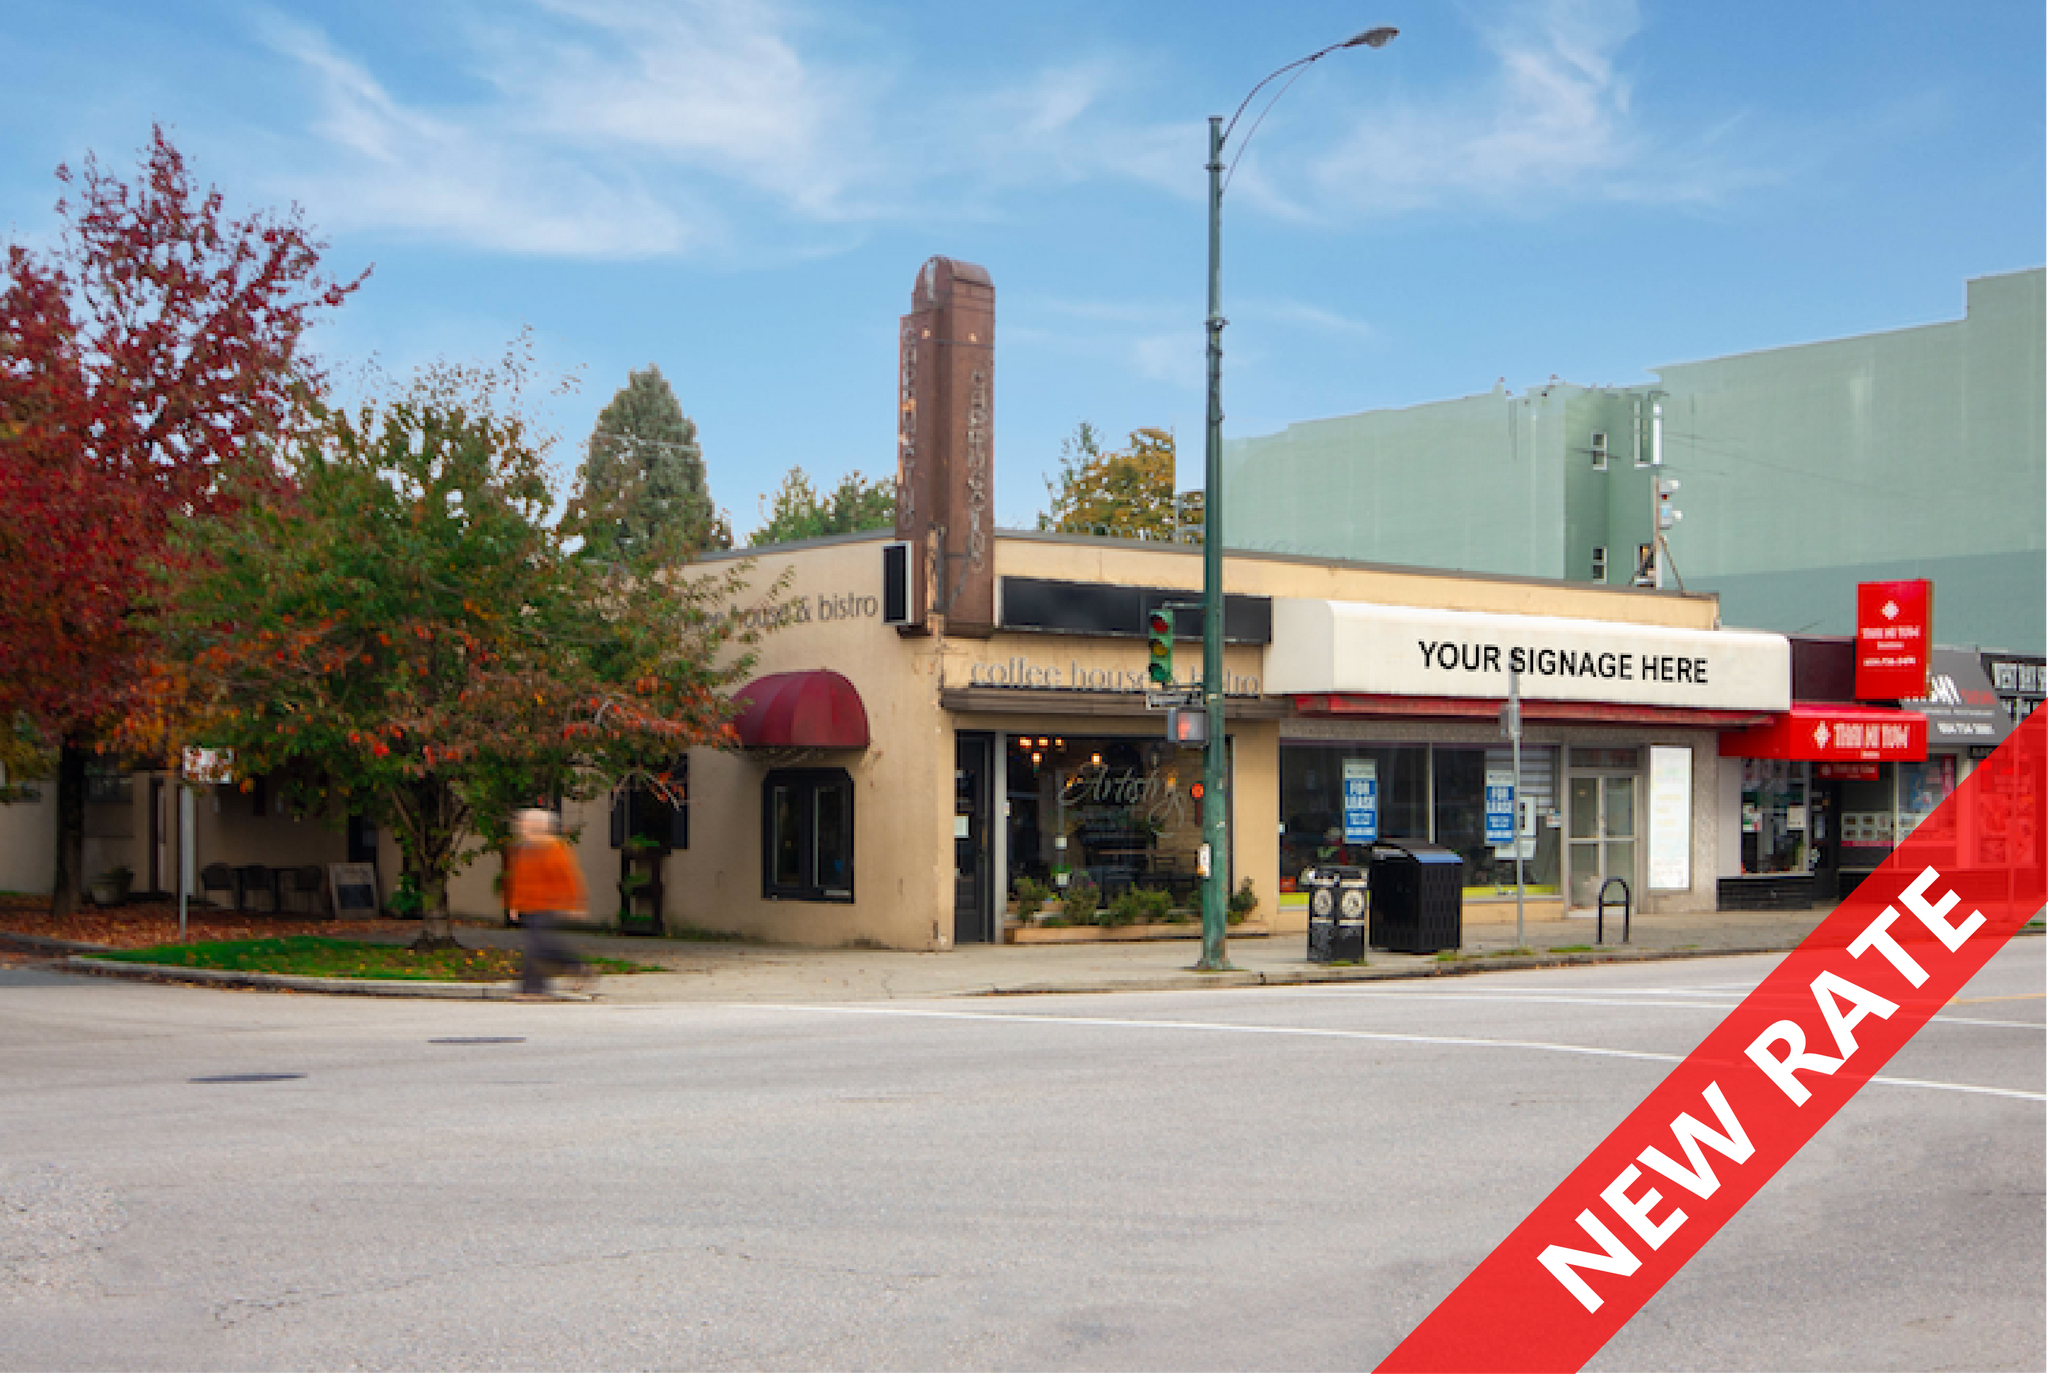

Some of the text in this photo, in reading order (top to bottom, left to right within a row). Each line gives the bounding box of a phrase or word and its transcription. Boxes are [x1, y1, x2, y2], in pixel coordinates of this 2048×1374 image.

[817, 590, 879, 621] bistro
[971, 657, 1063, 687] coffee
[1418, 640, 1709, 684] YOUR SIGNAGE HERE
